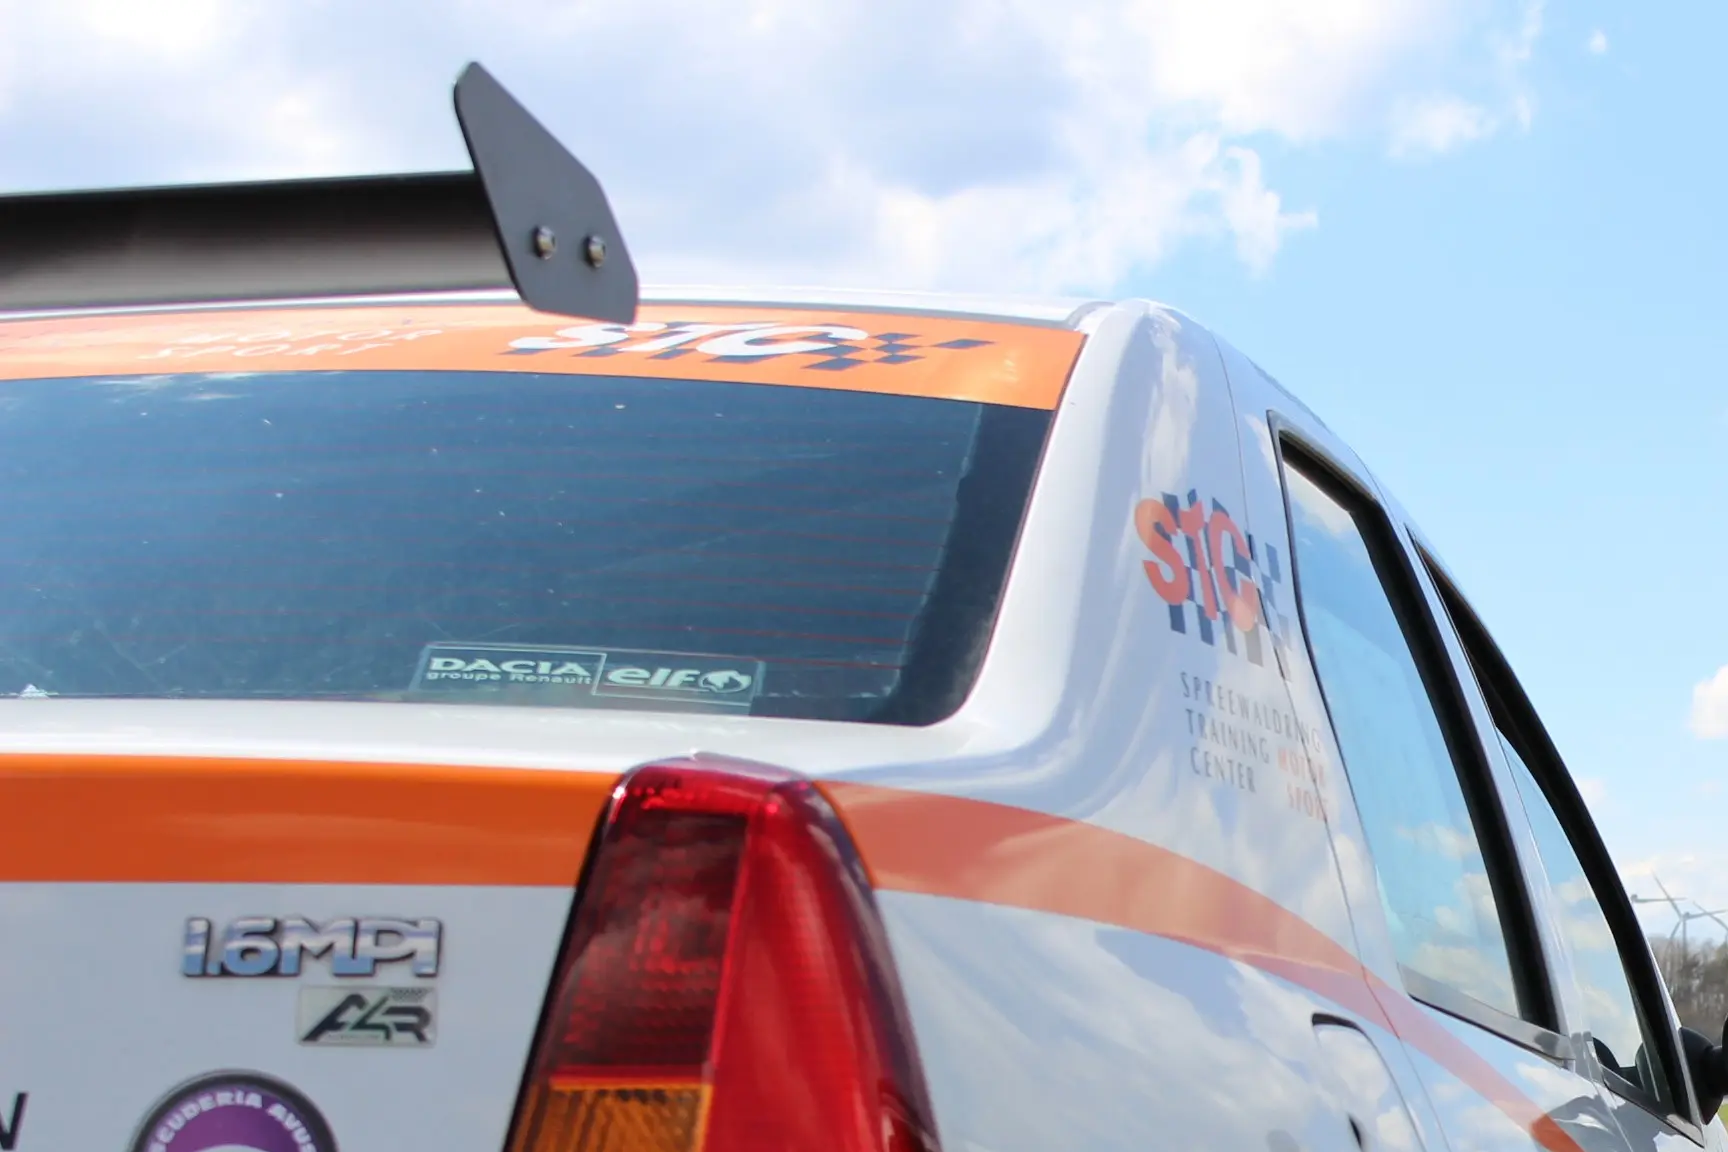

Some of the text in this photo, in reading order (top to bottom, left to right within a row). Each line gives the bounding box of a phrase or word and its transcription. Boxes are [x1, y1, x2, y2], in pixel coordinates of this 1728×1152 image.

[508, 321, 869, 357] STC
[1134, 497, 1259, 632] STC
[426, 671, 593, 686] groupe Renault
[429, 656, 592, 677] DACIA
[606, 667, 700, 688] elf
[1185, 708, 1271, 765] TRAINING
[1189, 746, 1256, 794] CENTER
